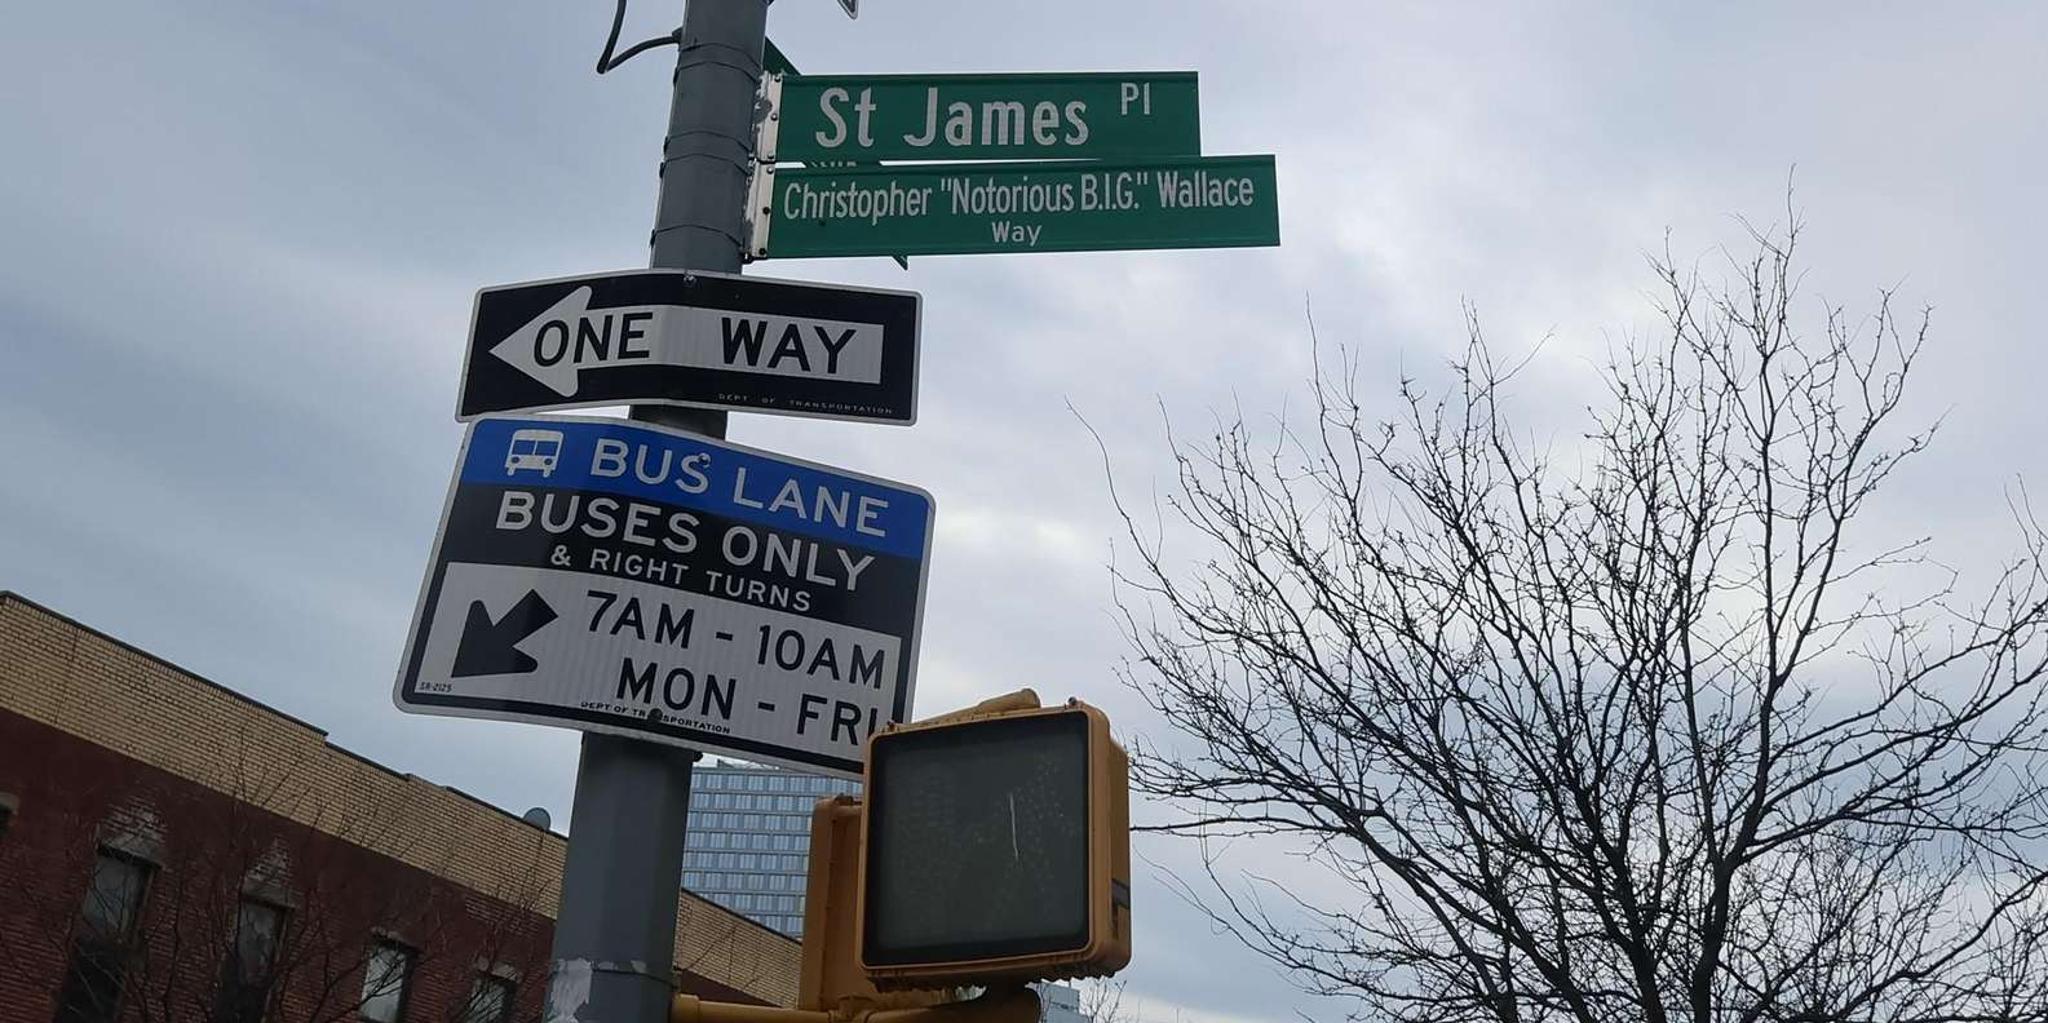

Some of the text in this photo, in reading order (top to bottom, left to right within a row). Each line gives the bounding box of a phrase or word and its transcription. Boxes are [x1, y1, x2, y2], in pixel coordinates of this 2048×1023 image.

[815, 88, 876, 149] St
[904, 86, 1088, 147] James
[784, 184, 932, 226] Christopher
[941, 176, 1075, 216] "Notorious
[1156, 170, 1255, 208] Wallace
[991, 221, 1042, 248] Way
[534, 312, 857, 374] ONE WAY
[591, 437, 889, 537] BUS LANE
[496, 490, 875, 592] BUSES ONLY
[551, 544, 811, 613] & RIGHT TURNS
[586, 589, 695, 651] 7AM
[757, 624, 886, 691] 10AM
[581, 701, 731, 735] DEPT OF TRSPORTATION
[617, 657, 737, 721] MON
[796, 693, 878, 746] FRI
